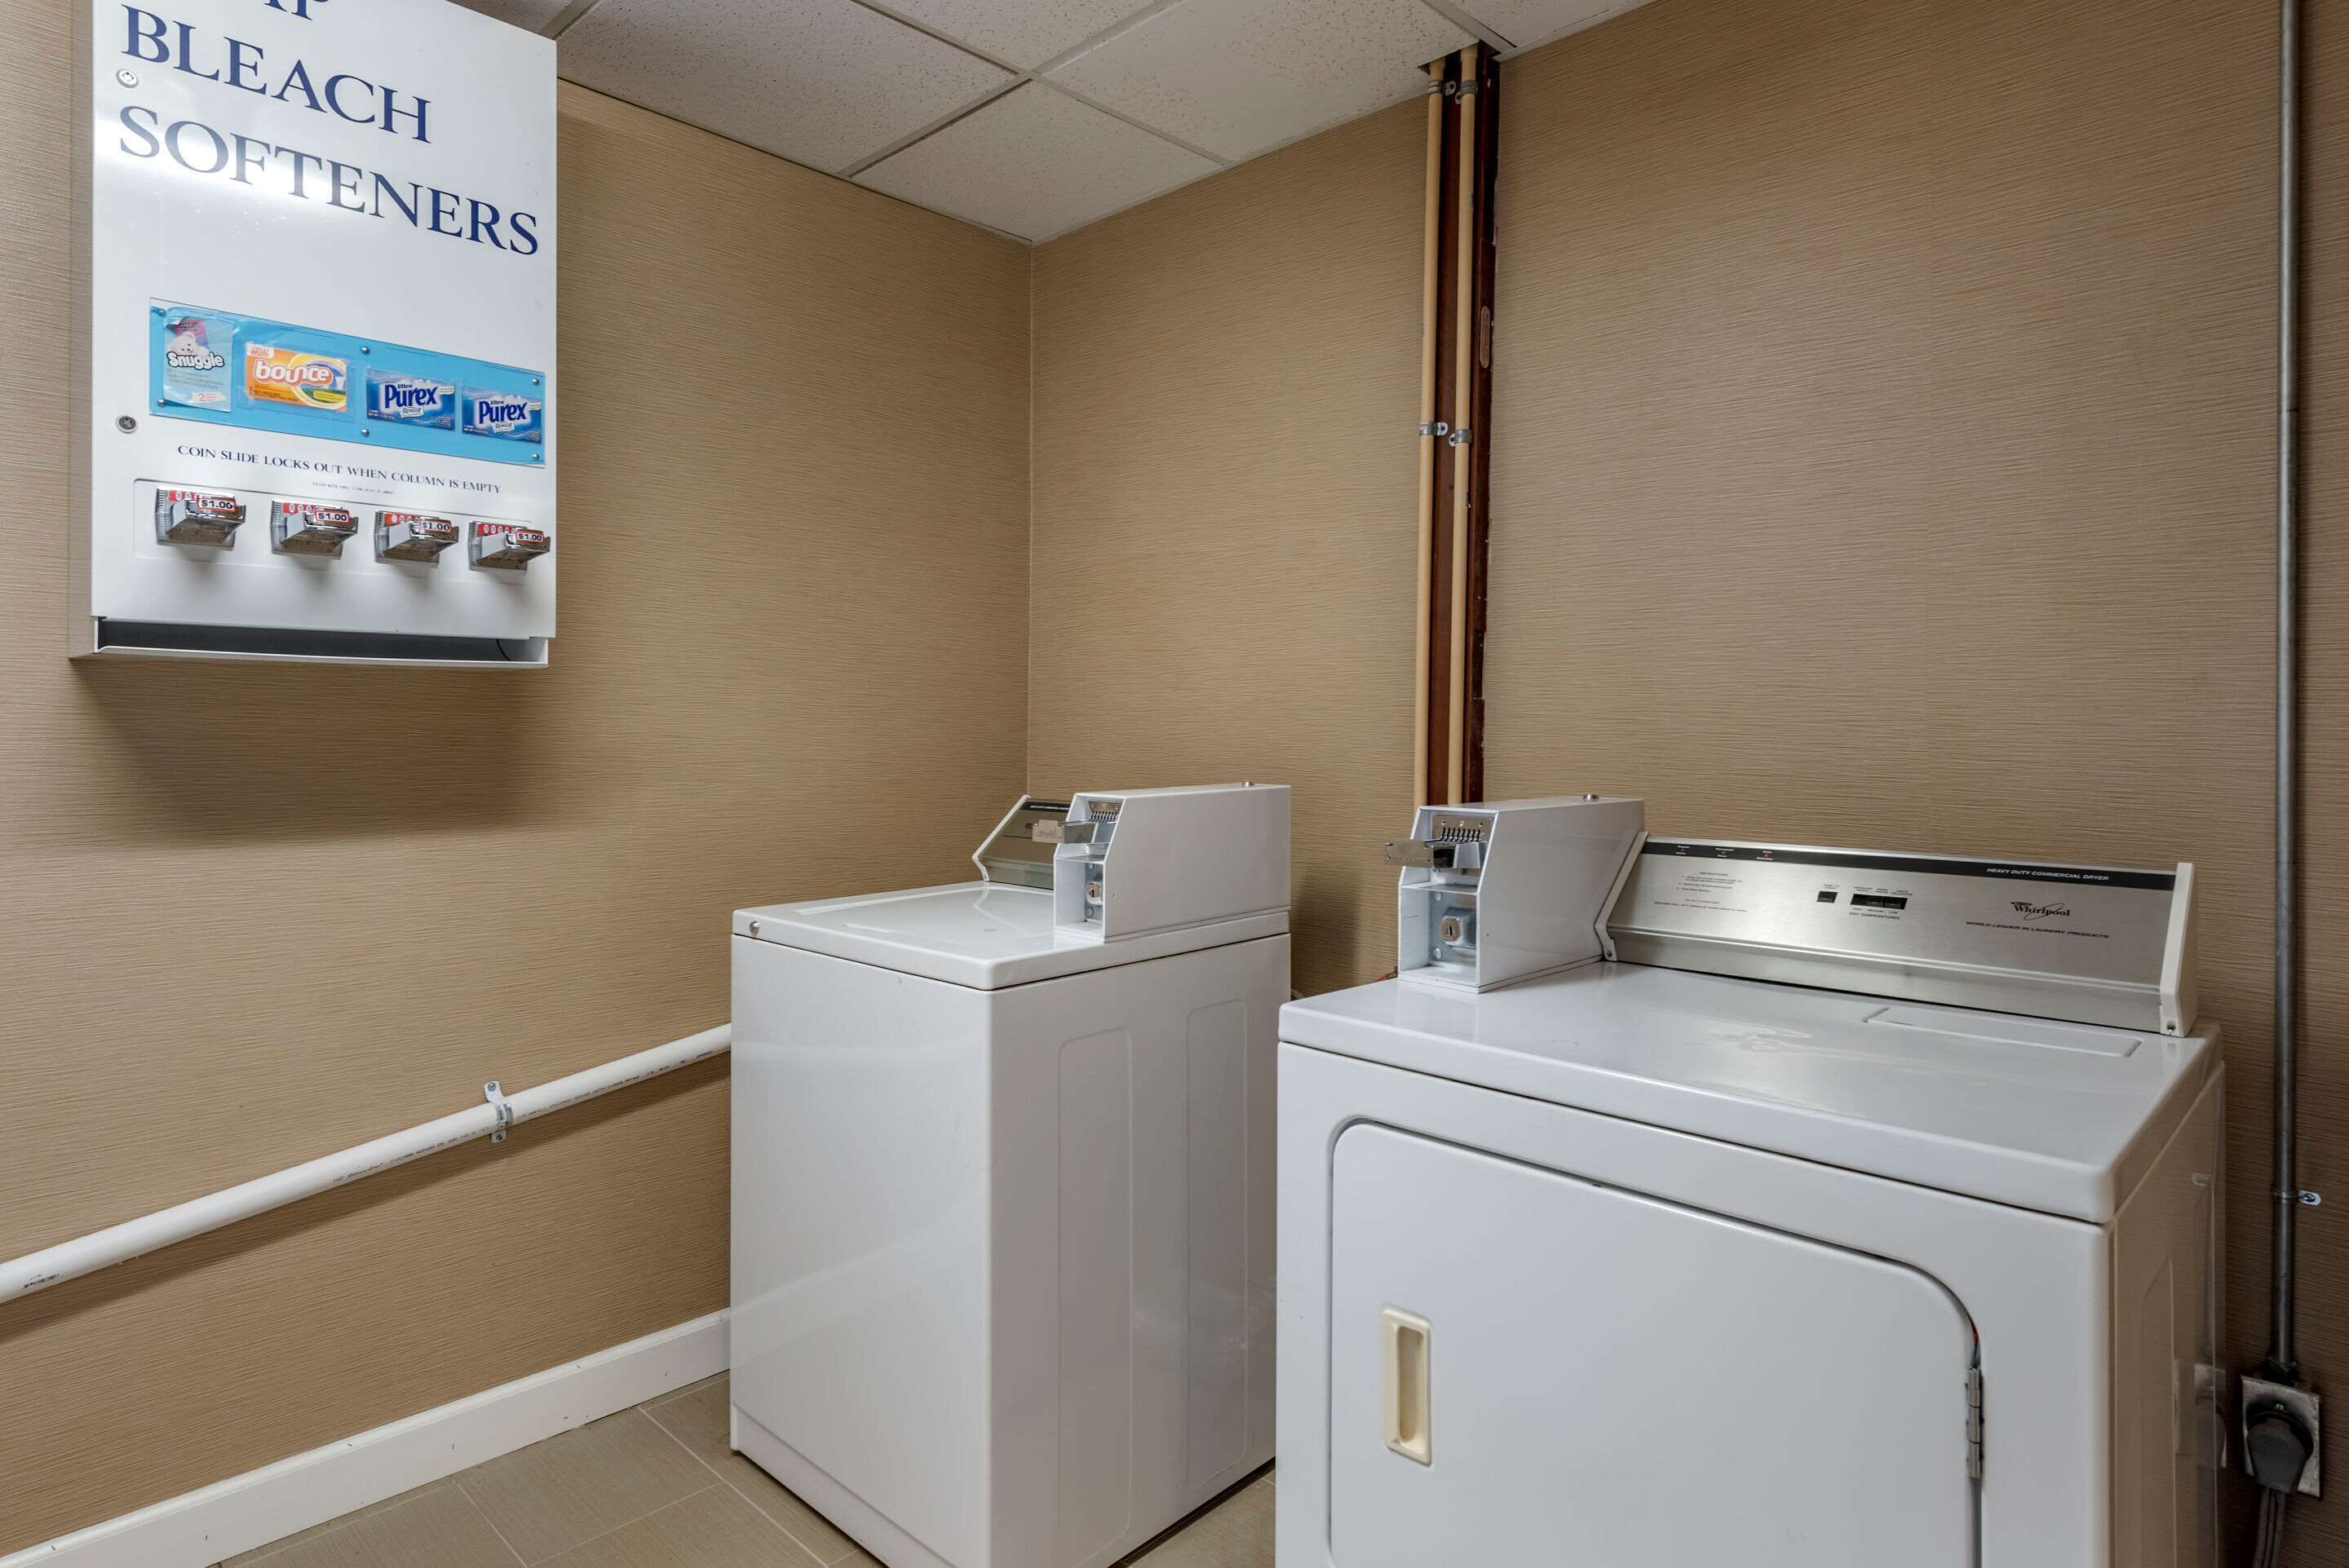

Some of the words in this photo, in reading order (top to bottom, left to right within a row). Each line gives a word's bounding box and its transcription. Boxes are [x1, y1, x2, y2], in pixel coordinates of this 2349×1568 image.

[122, 4, 431, 144] BLEACH
[120, 105, 538, 255] SOFTENERS
[166, 351, 225, 371] Snuggle
[254, 359, 332, 384] bounce
[384, 384, 439, 409] Purex
[479, 400, 529, 424] Purex
[178, 445, 216, 458] COIN
[221, 450, 259, 464] SLIDE
[264, 456, 310, 470] LOCKS
[314, 462, 343, 474] OUT
[347, 466, 387, 479] WHEN
[391, 471, 445, 486] COLUMN
[449, 479, 459, 488] IS
[462, 481, 502, 493] EMPTY
[201, 499, 233, 510] $1.00
[318, 512, 347, 521] $1.00
[422, 522, 450, 531] $1.00
[518, 533, 542, 541] $1.00
[2031, 870, 2082, 879] COMMERCIAL
[2014, 904, 2070, 917] Whirlpool
